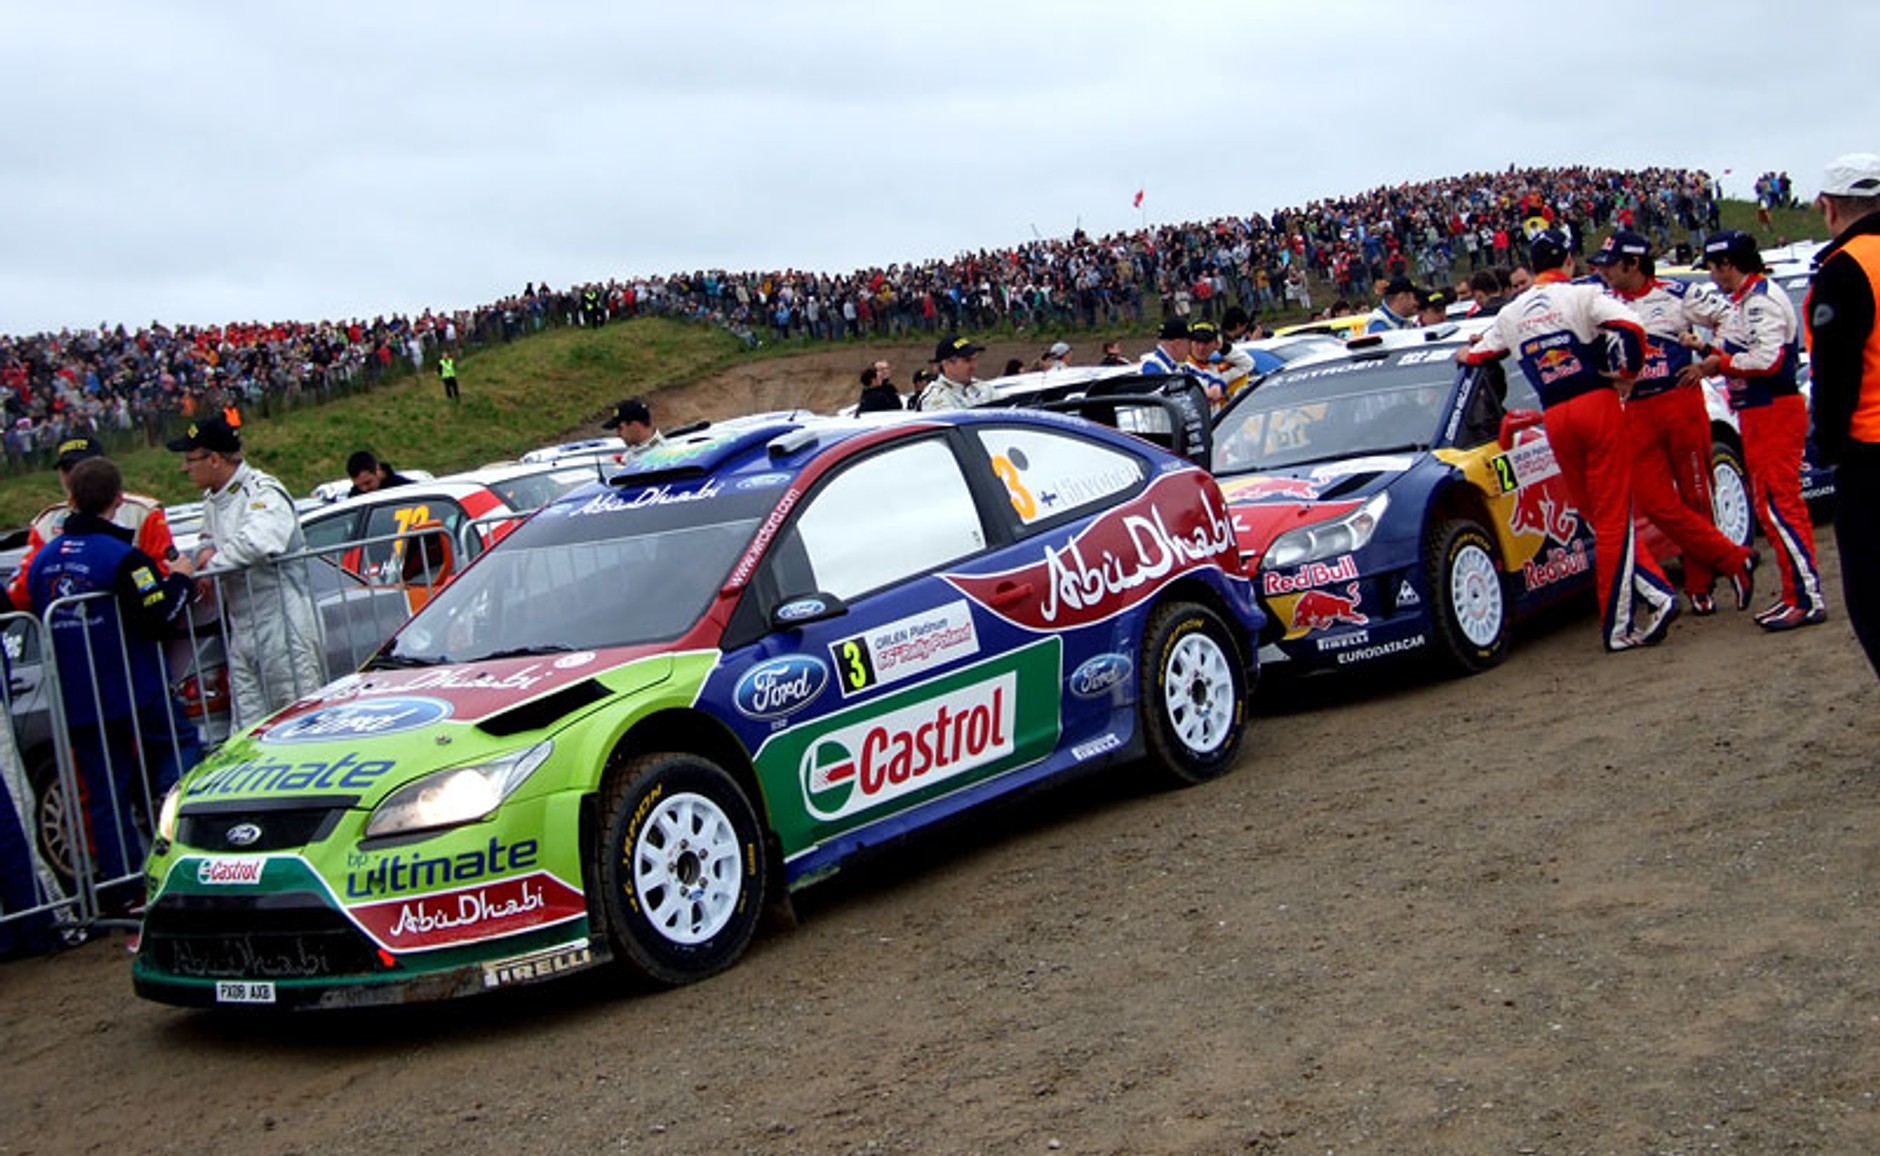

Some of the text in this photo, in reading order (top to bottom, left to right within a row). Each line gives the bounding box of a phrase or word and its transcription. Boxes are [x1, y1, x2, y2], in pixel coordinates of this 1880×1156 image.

[991, 455, 1037, 520] 3
[1496, 457, 1514, 491] 2
[1123, 489, 1237, 578] Dhabi
[1264, 554, 1360, 596] Red Bull
[843, 641, 867, 689] 3
[1337, 634, 1426, 664] EURODATACAR
[753, 665, 812, 711] Ford
[1081, 661, 1120, 693] Ford
[860, 686, 1004, 795] Castrol
[187, 752, 396, 796] ultimate
[210, 859, 260, 884] Castrol
[346, 836, 538, 898] ultimate
[348, 851, 368, 869] bp
[390, 881, 545, 936] Abu Dhabi
